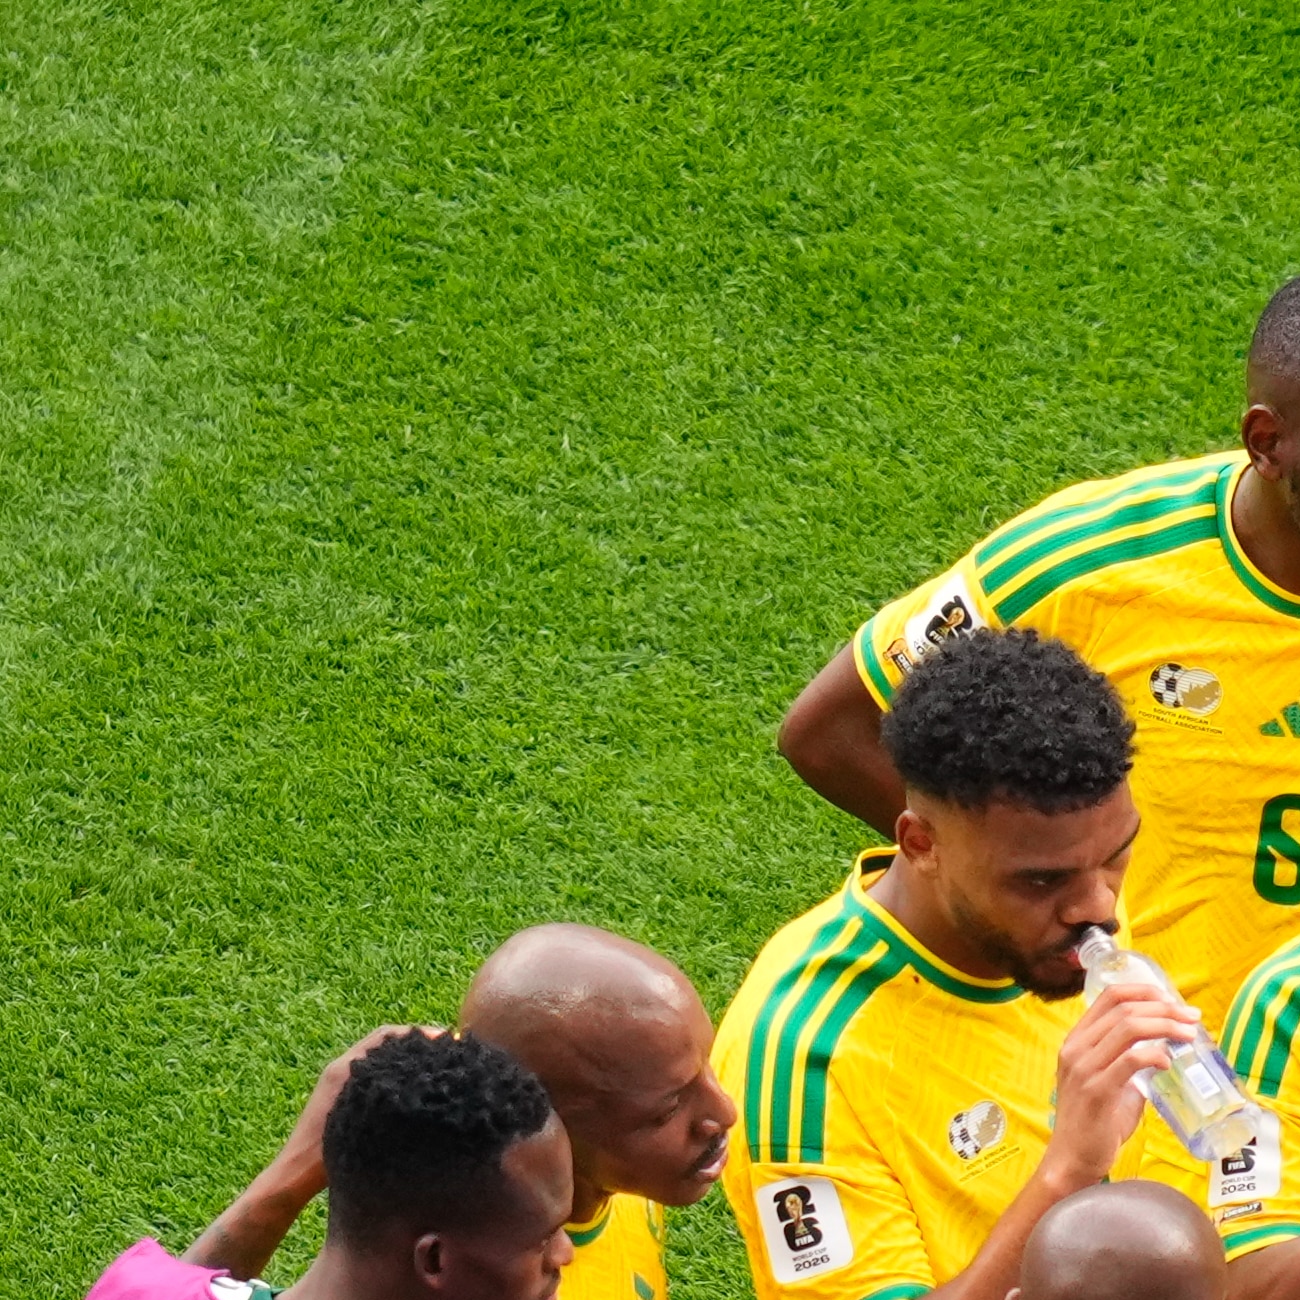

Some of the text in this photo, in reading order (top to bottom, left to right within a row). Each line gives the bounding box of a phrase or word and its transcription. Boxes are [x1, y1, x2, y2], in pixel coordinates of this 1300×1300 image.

[1227, 1160, 1247, 1172] FIFA
[1221, 1182, 1257, 1196] 2026
[794, 1233, 816, 1248] FIFA
[793, 1254, 831, 1273] 2026
